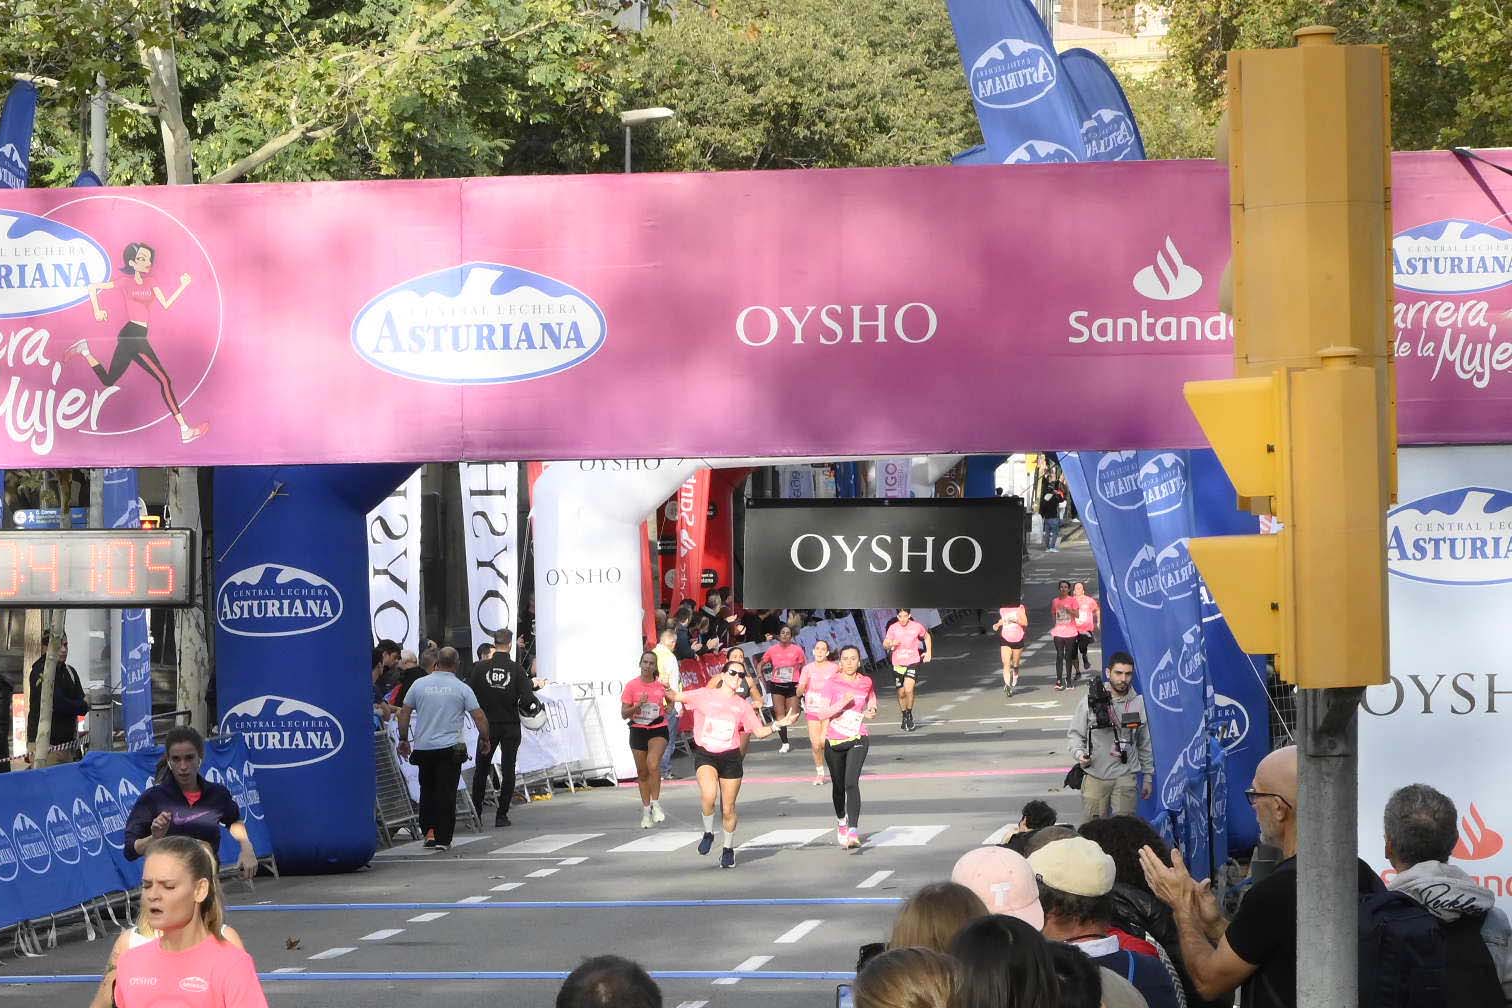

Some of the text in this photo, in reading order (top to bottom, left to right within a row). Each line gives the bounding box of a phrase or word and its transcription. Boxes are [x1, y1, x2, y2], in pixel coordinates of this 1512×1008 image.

[14, 246, 87, 258] LECHERA
[496, 303, 578, 316] LECHERA
[1392, 299, 1489, 331] arrera
[372, 309, 587, 354] ASTURIANA
[735, 303, 938, 346] OYSHO
[1069, 310, 1235, 343] Santand
[1418, 330, 1435, 358] la
[1430, 325, 1512, 390] Muje
[1415, 522, 1482, 533] CENTRAL
[790, 533, 983, 574] OYSHO
[545, 567, 623, 585] OYSHO
[233, 588, 329, 598] CENTRAL LECHERA
[220, 593, 334, 621] ASTURIANA
[491, 673, 505, 682] BP
[235, 719, 331, 730] CENTRAL LECHERA
